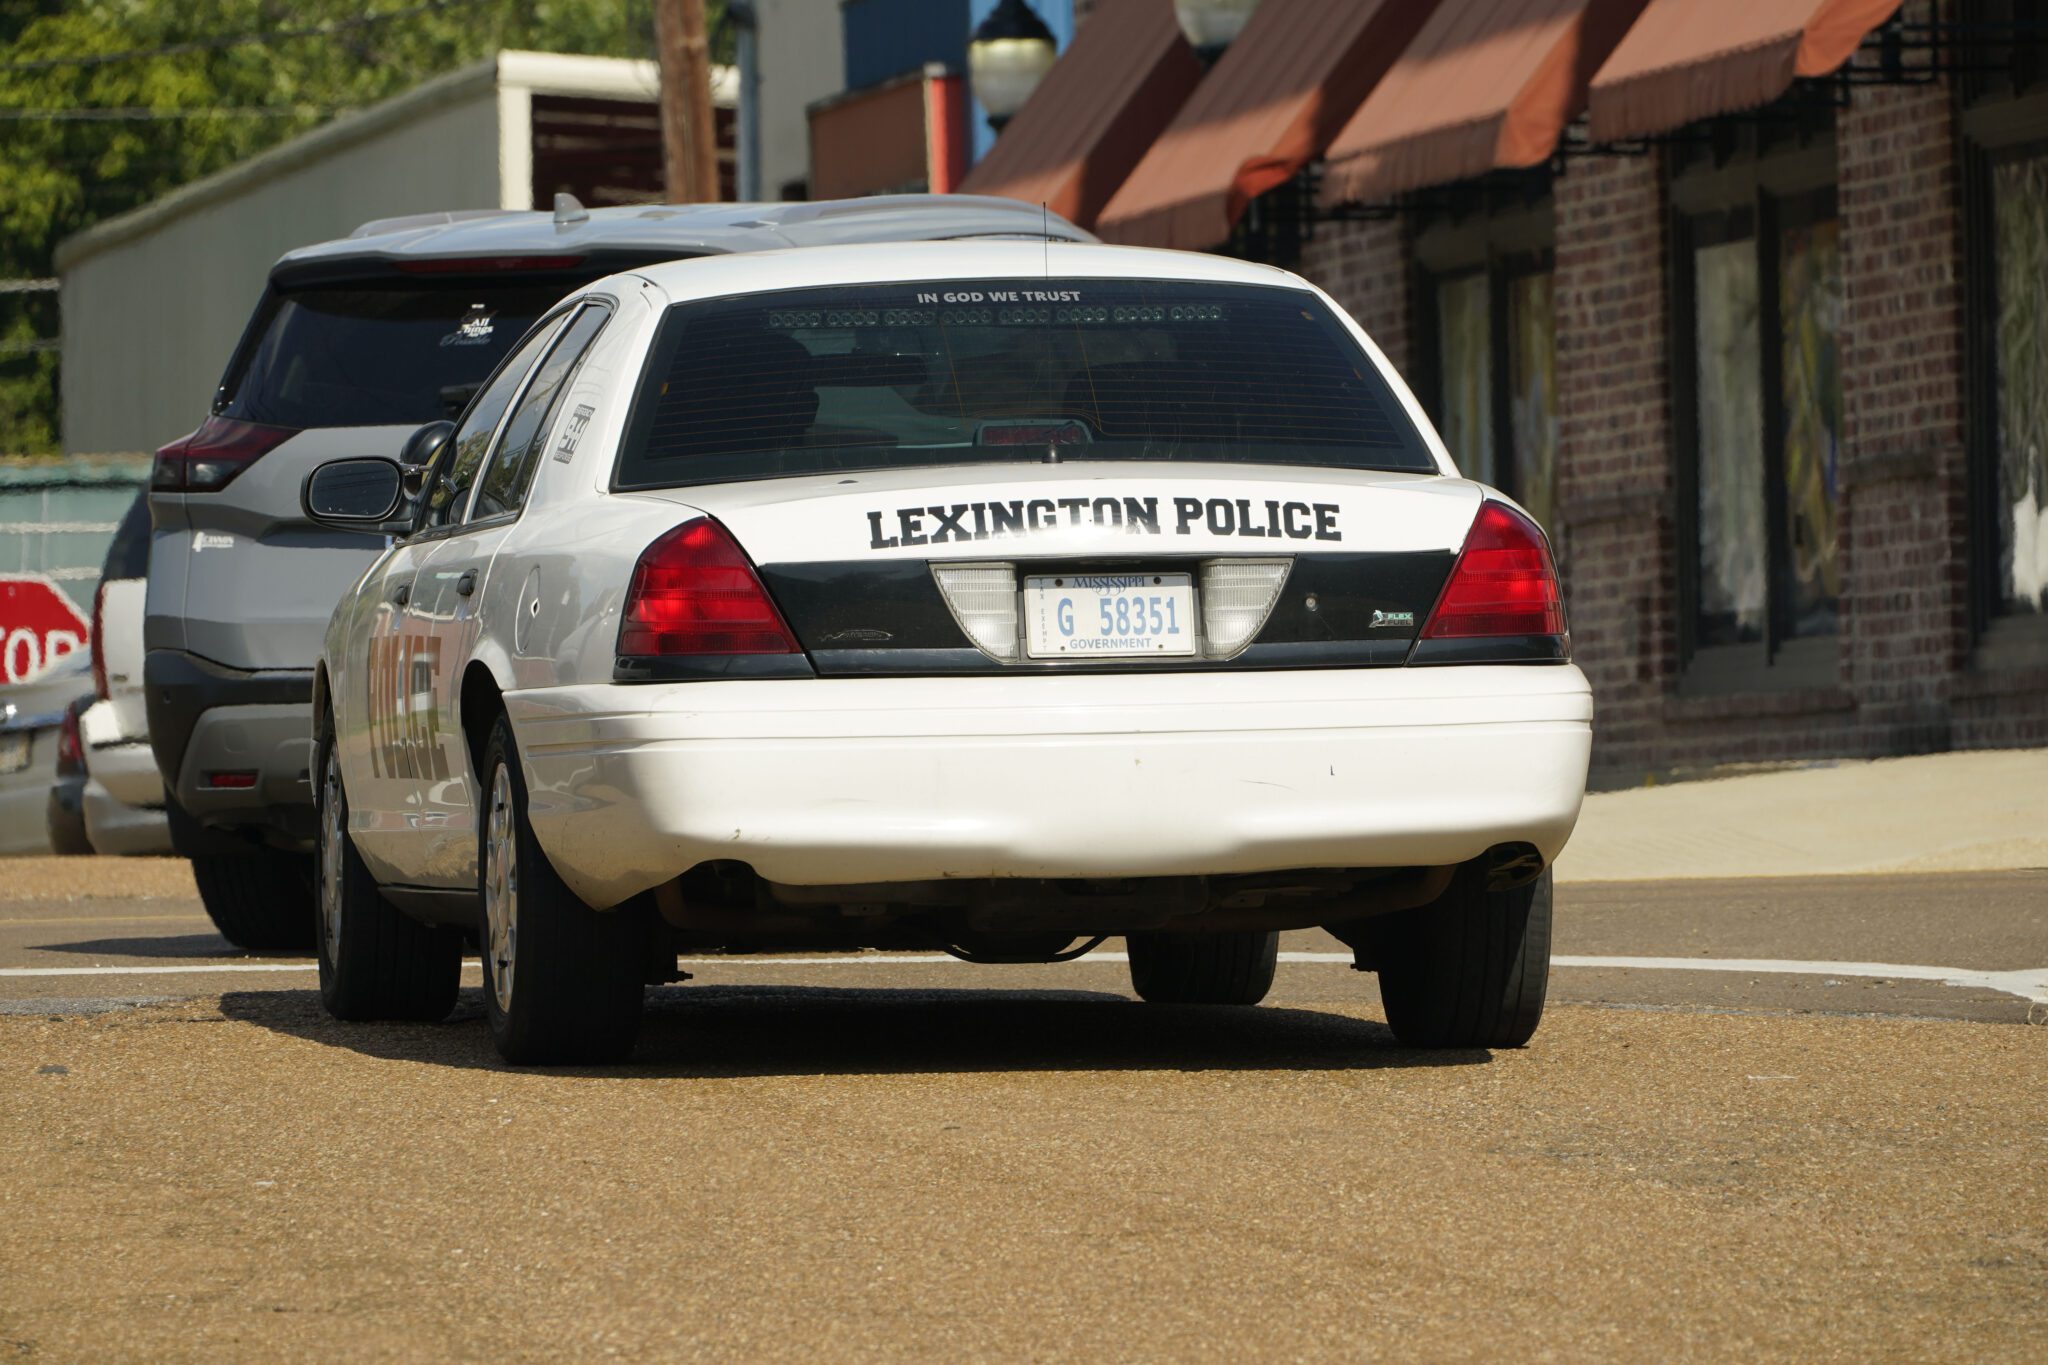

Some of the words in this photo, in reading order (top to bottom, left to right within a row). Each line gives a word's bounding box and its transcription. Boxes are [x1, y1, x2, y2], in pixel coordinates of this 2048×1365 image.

[917, 293, 938, 303] IN
[943, 292, 984, 302] GOD
[988, 291, 1019, 301] WE
[1022, 291, 1081, 301] TRUST
[867, 497, 1161, 549] LEXINGTON
[1173, 497, 1342, 541] POLICE
[1072, 576, 1145, 592] MISSISSIPPI
[1057, 597, 1075, 637] G
[1099, 596, 1180, 637] 58351
[1386, 612, 1412, 620] FLEX
[0, 626, 80, 684] OP
[1070, 638, 1152, 650] GOVERNMENT
[368, 635, 451, 781] POLICE
